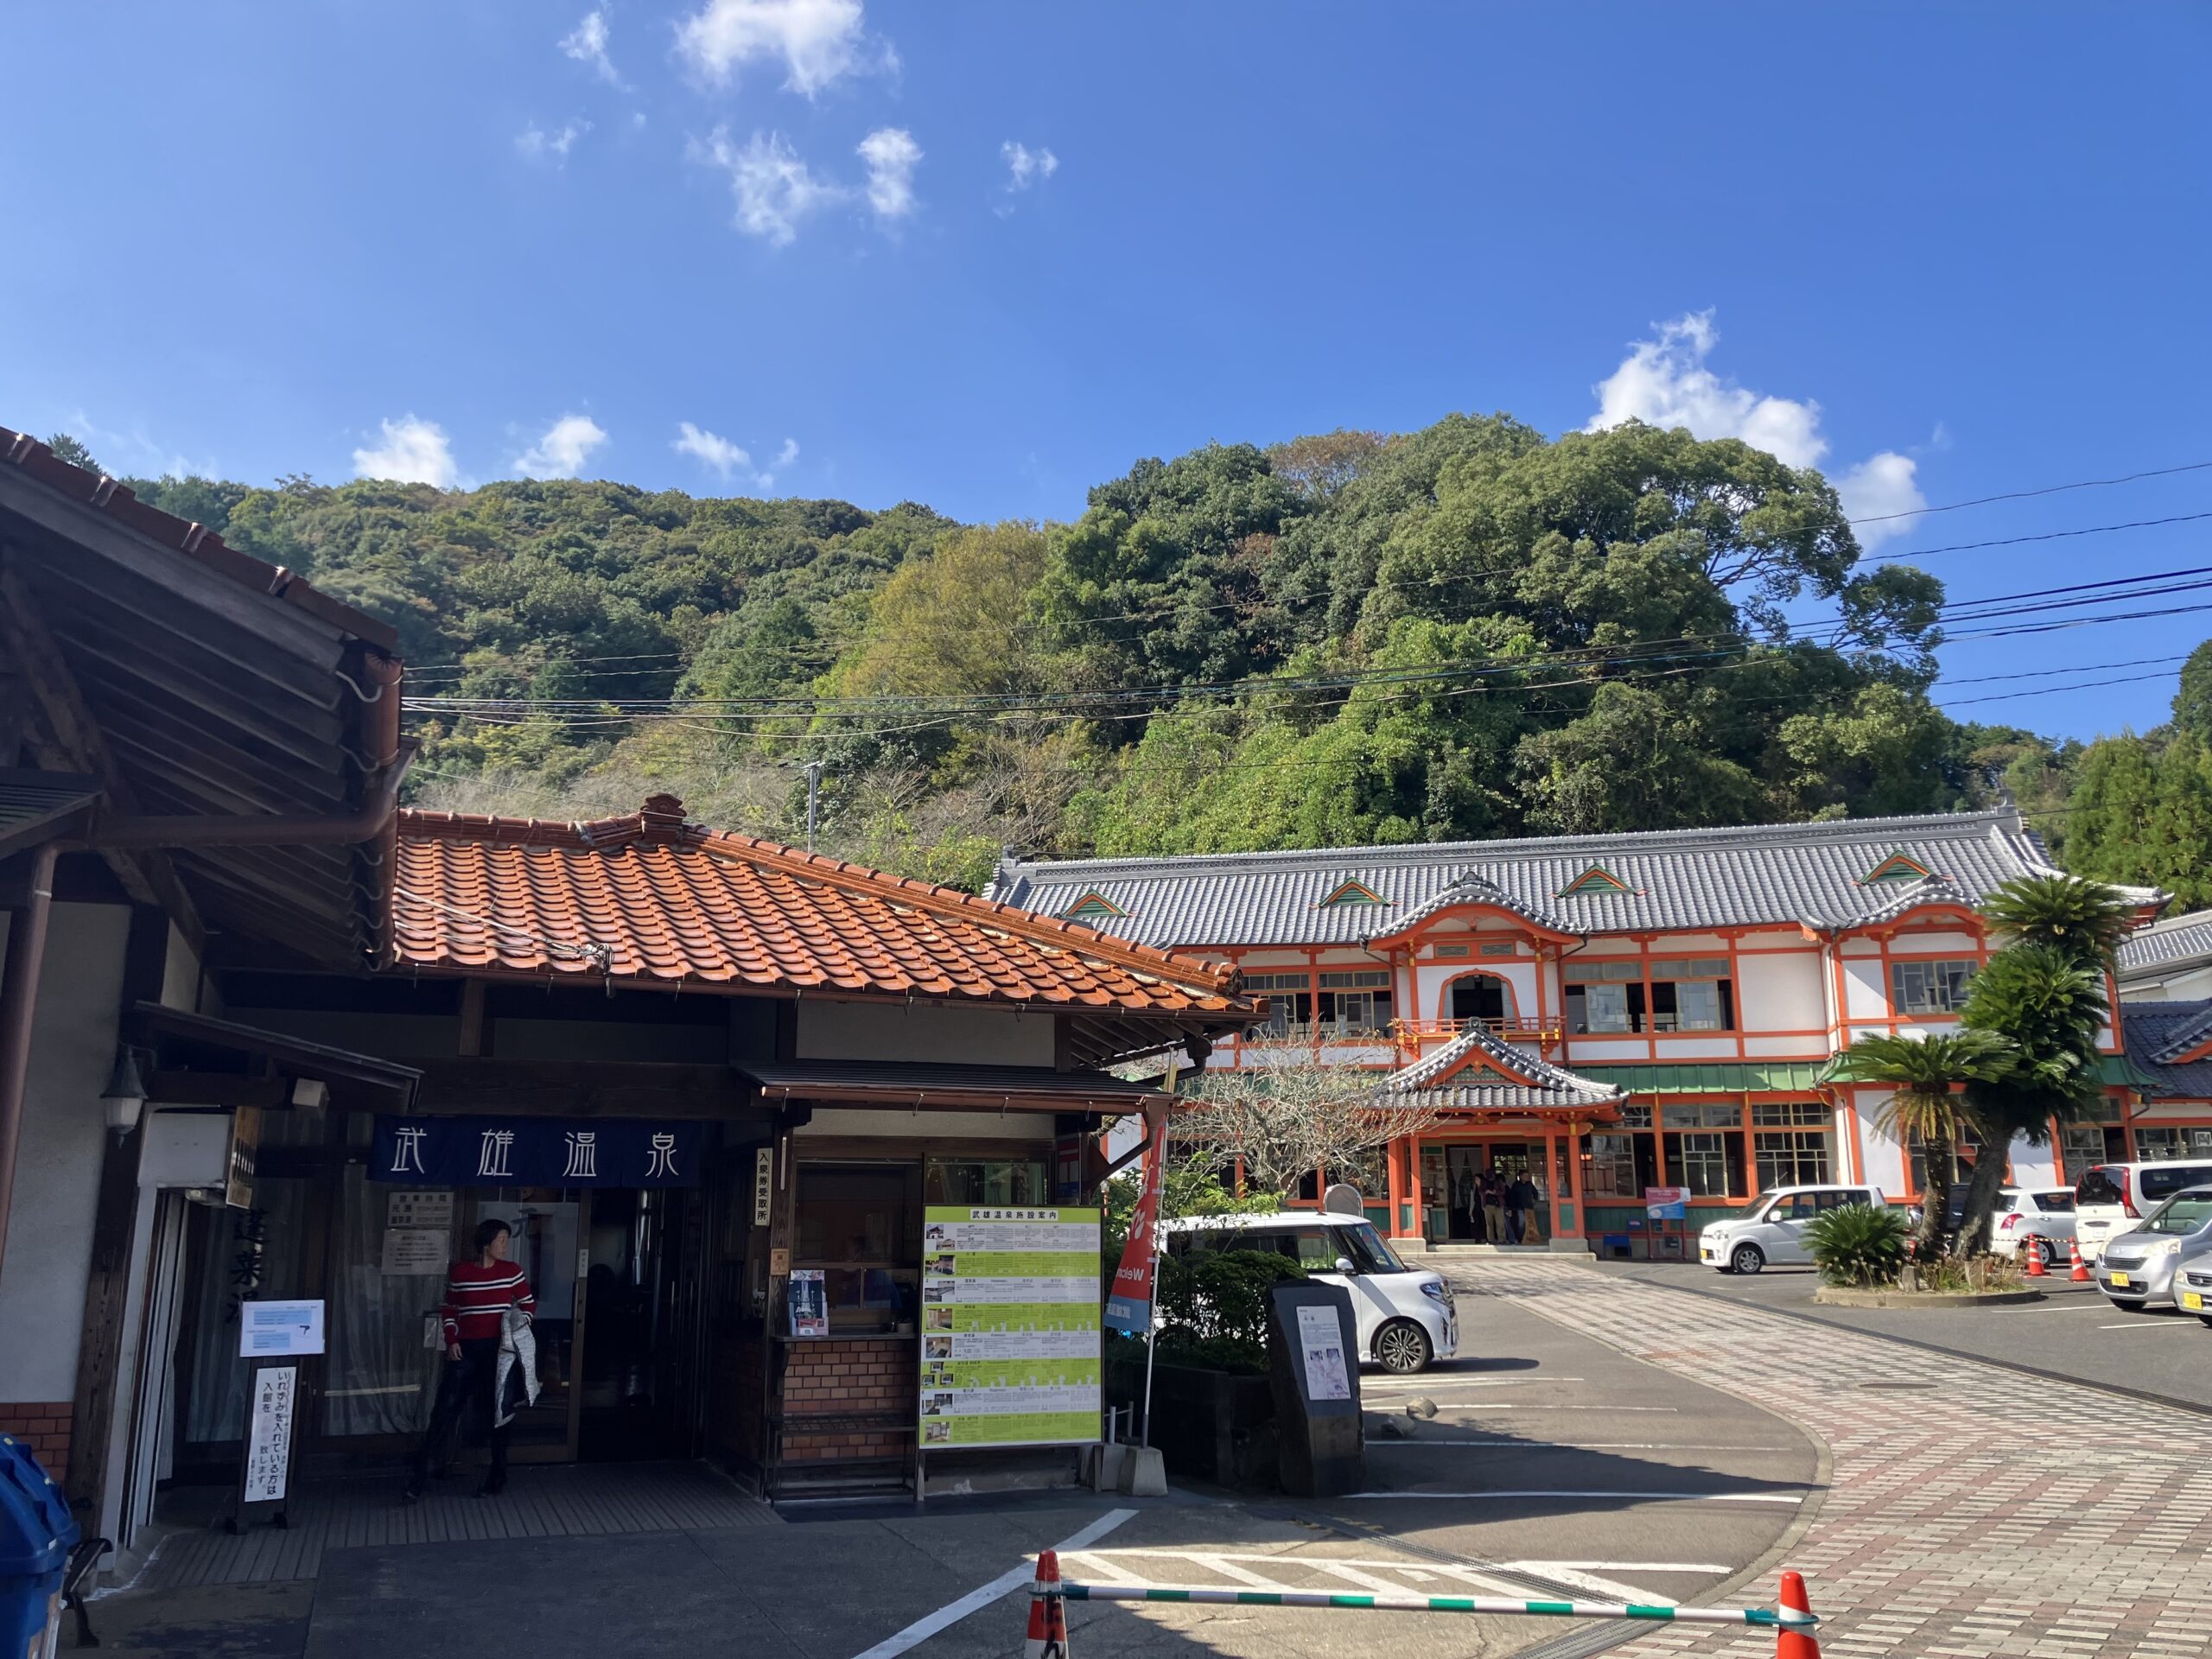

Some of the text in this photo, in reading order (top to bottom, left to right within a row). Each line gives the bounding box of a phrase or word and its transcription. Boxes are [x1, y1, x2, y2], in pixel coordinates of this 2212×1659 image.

[390, 1126, 678, 1179] 武雄温泉
[757, 1153, 769, 1220] 入泉券受取所
[972, 1211, 1056, 1219] 武雄温泉施設案内
[267, 1371, 288, 1495] いれずみを入れている方は
